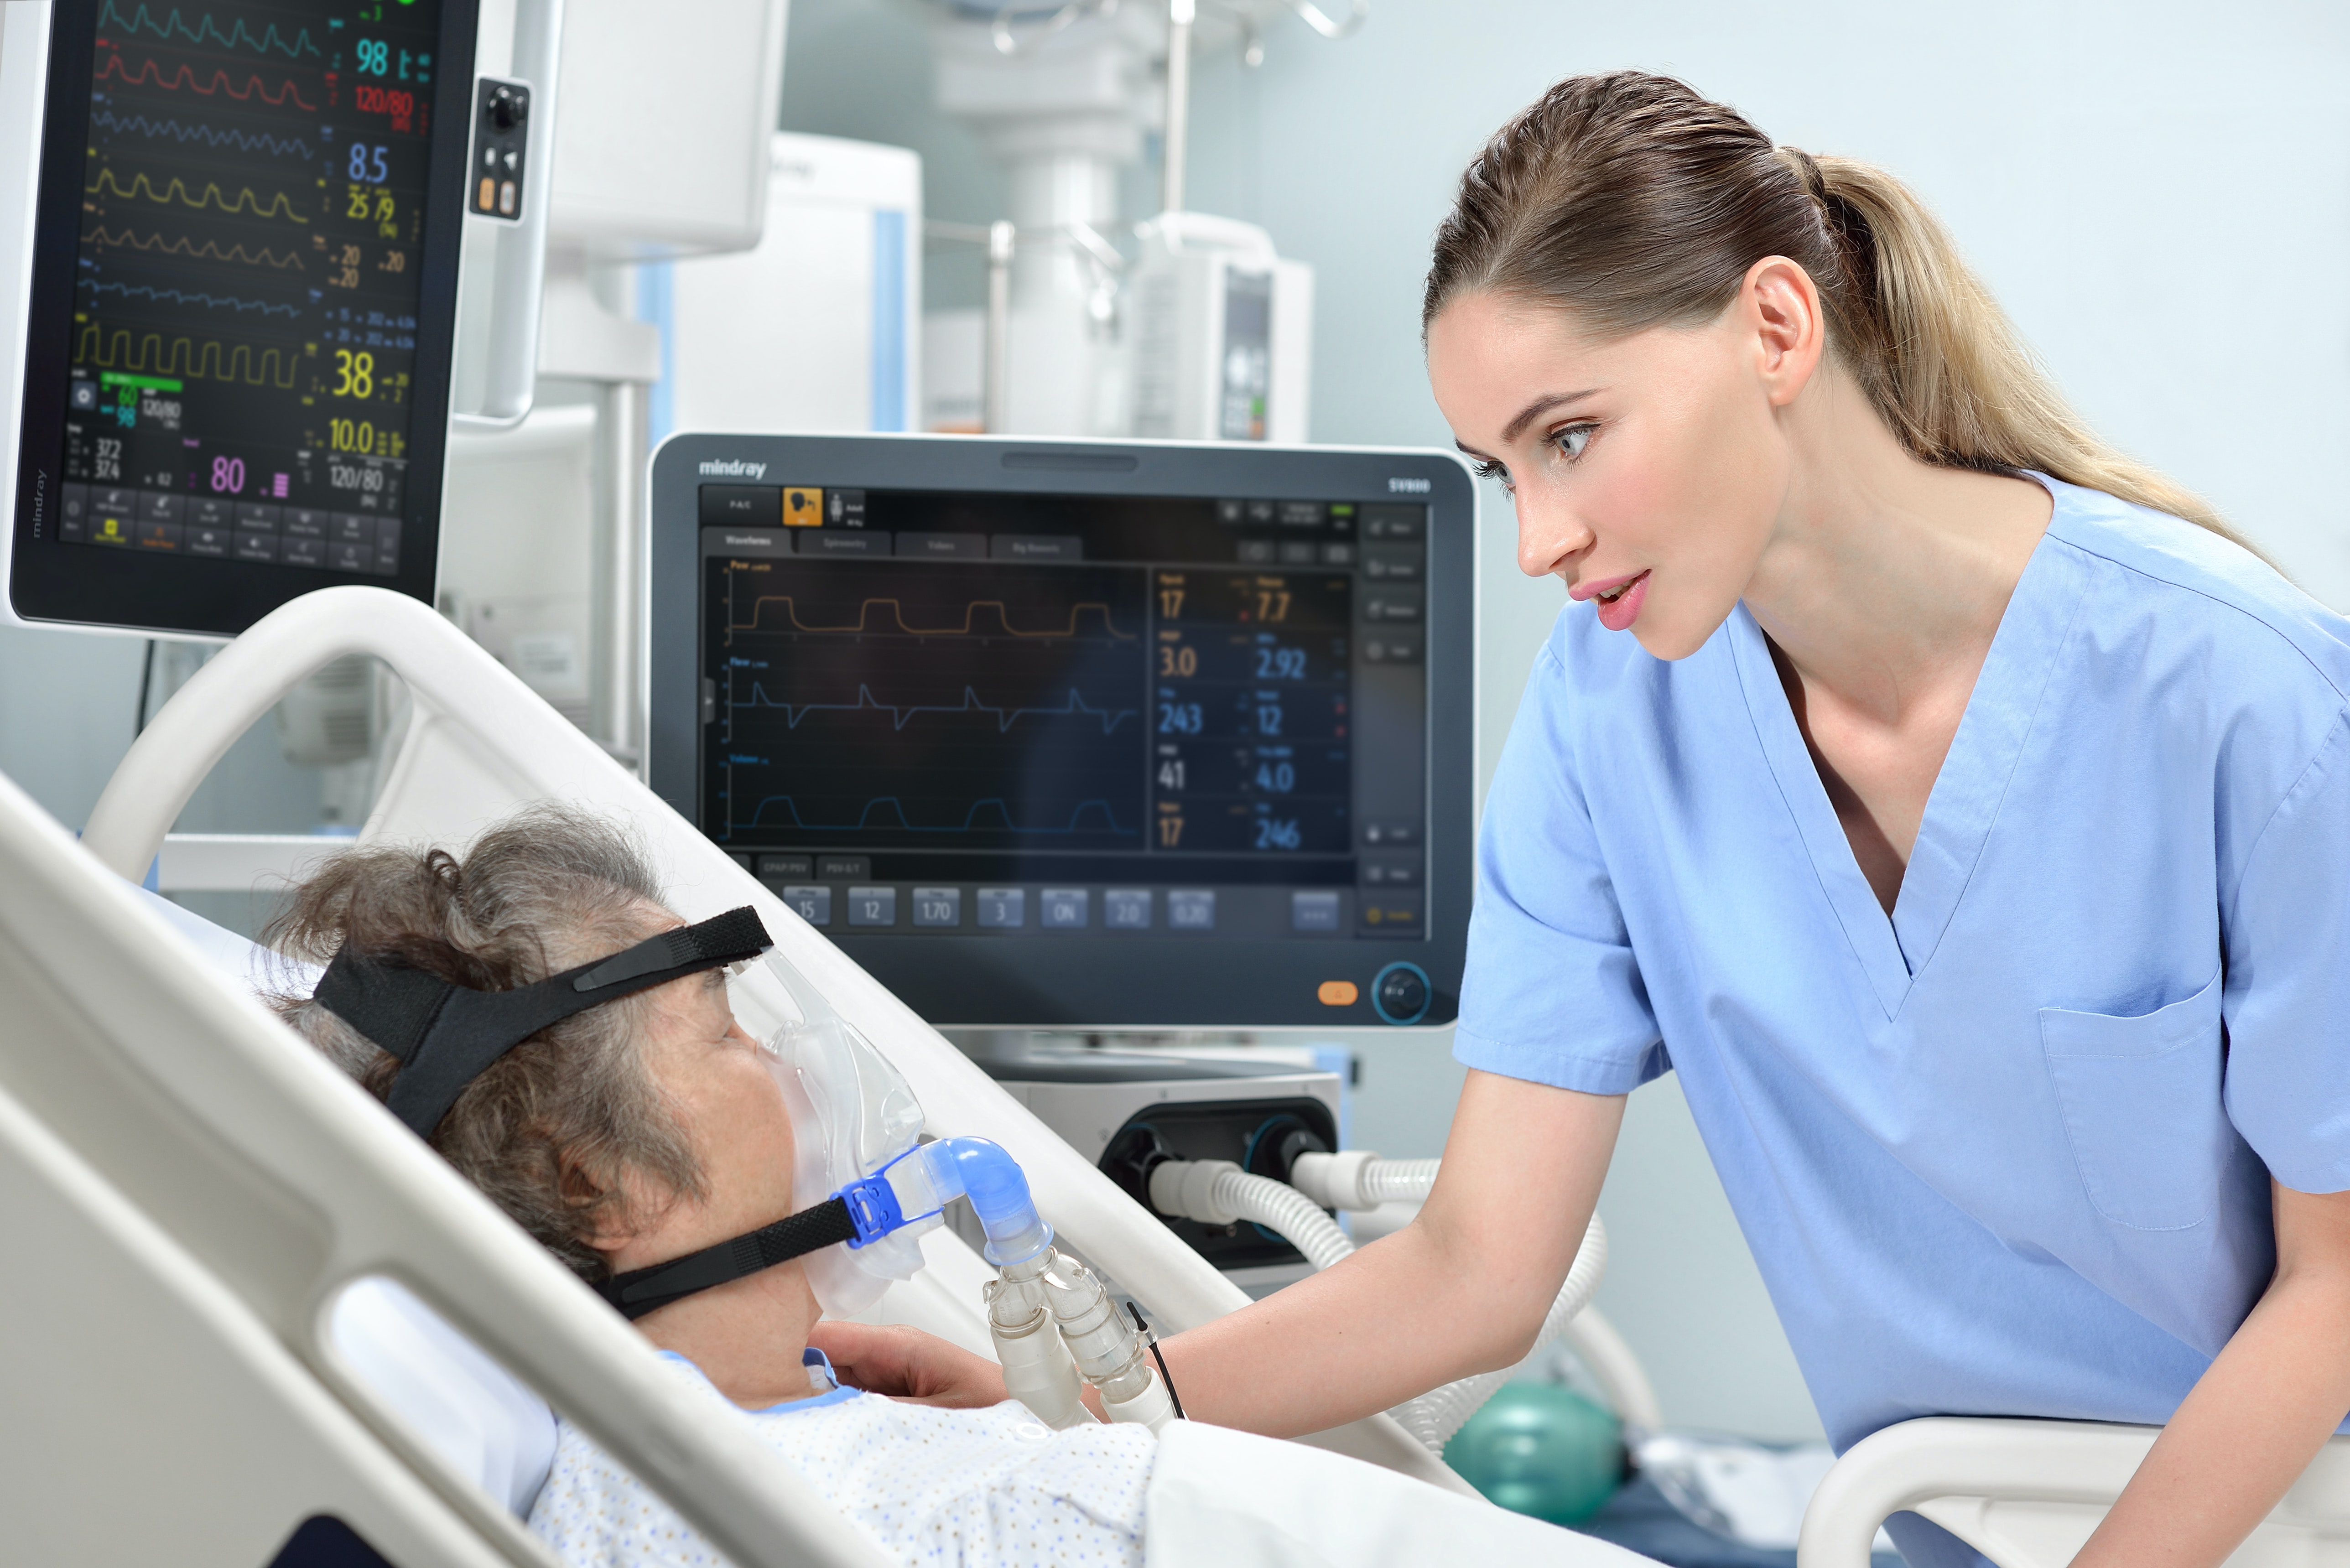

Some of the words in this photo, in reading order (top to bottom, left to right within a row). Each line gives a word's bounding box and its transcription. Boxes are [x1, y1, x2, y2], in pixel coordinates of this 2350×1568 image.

[357, 39, 388, 76] 98
[355, 86, 414, 117] 120/80
[348, 143, 387, 183] 8.5
[333, 348, 375, 400] 38
[117, 406, 136, 428] 98
[330, 417, 374, 454] 10.0
[211, 456, 245, 493] 80
[331, 465, 384, 491] 120/80
[699, 458, 767, 480] mindray
[33, 468, 47, 538] mindray
[726, 535, 772, 545] Waveforms
[1159, 590, 1185, 619] 17
[1257, 592, 1290, 622] 7.7
[1159, 646, 1197, 677] 3.0
[1257, 648, 1306, 680] 2.92
[1159, 703, 1203, 734] 243
[1257, 705, 1283, 735] 12
[1159, 760, 1185, 789] 41
[1159, 817, 1184, 846] 17
[1256, 817, 1300, 849] 246
[799, 900, 815, 920] 15
[865, 901, 880, 920] 12
[923, 902, 951, 921] 1.70
[995, 902, 1006, 922] 3
